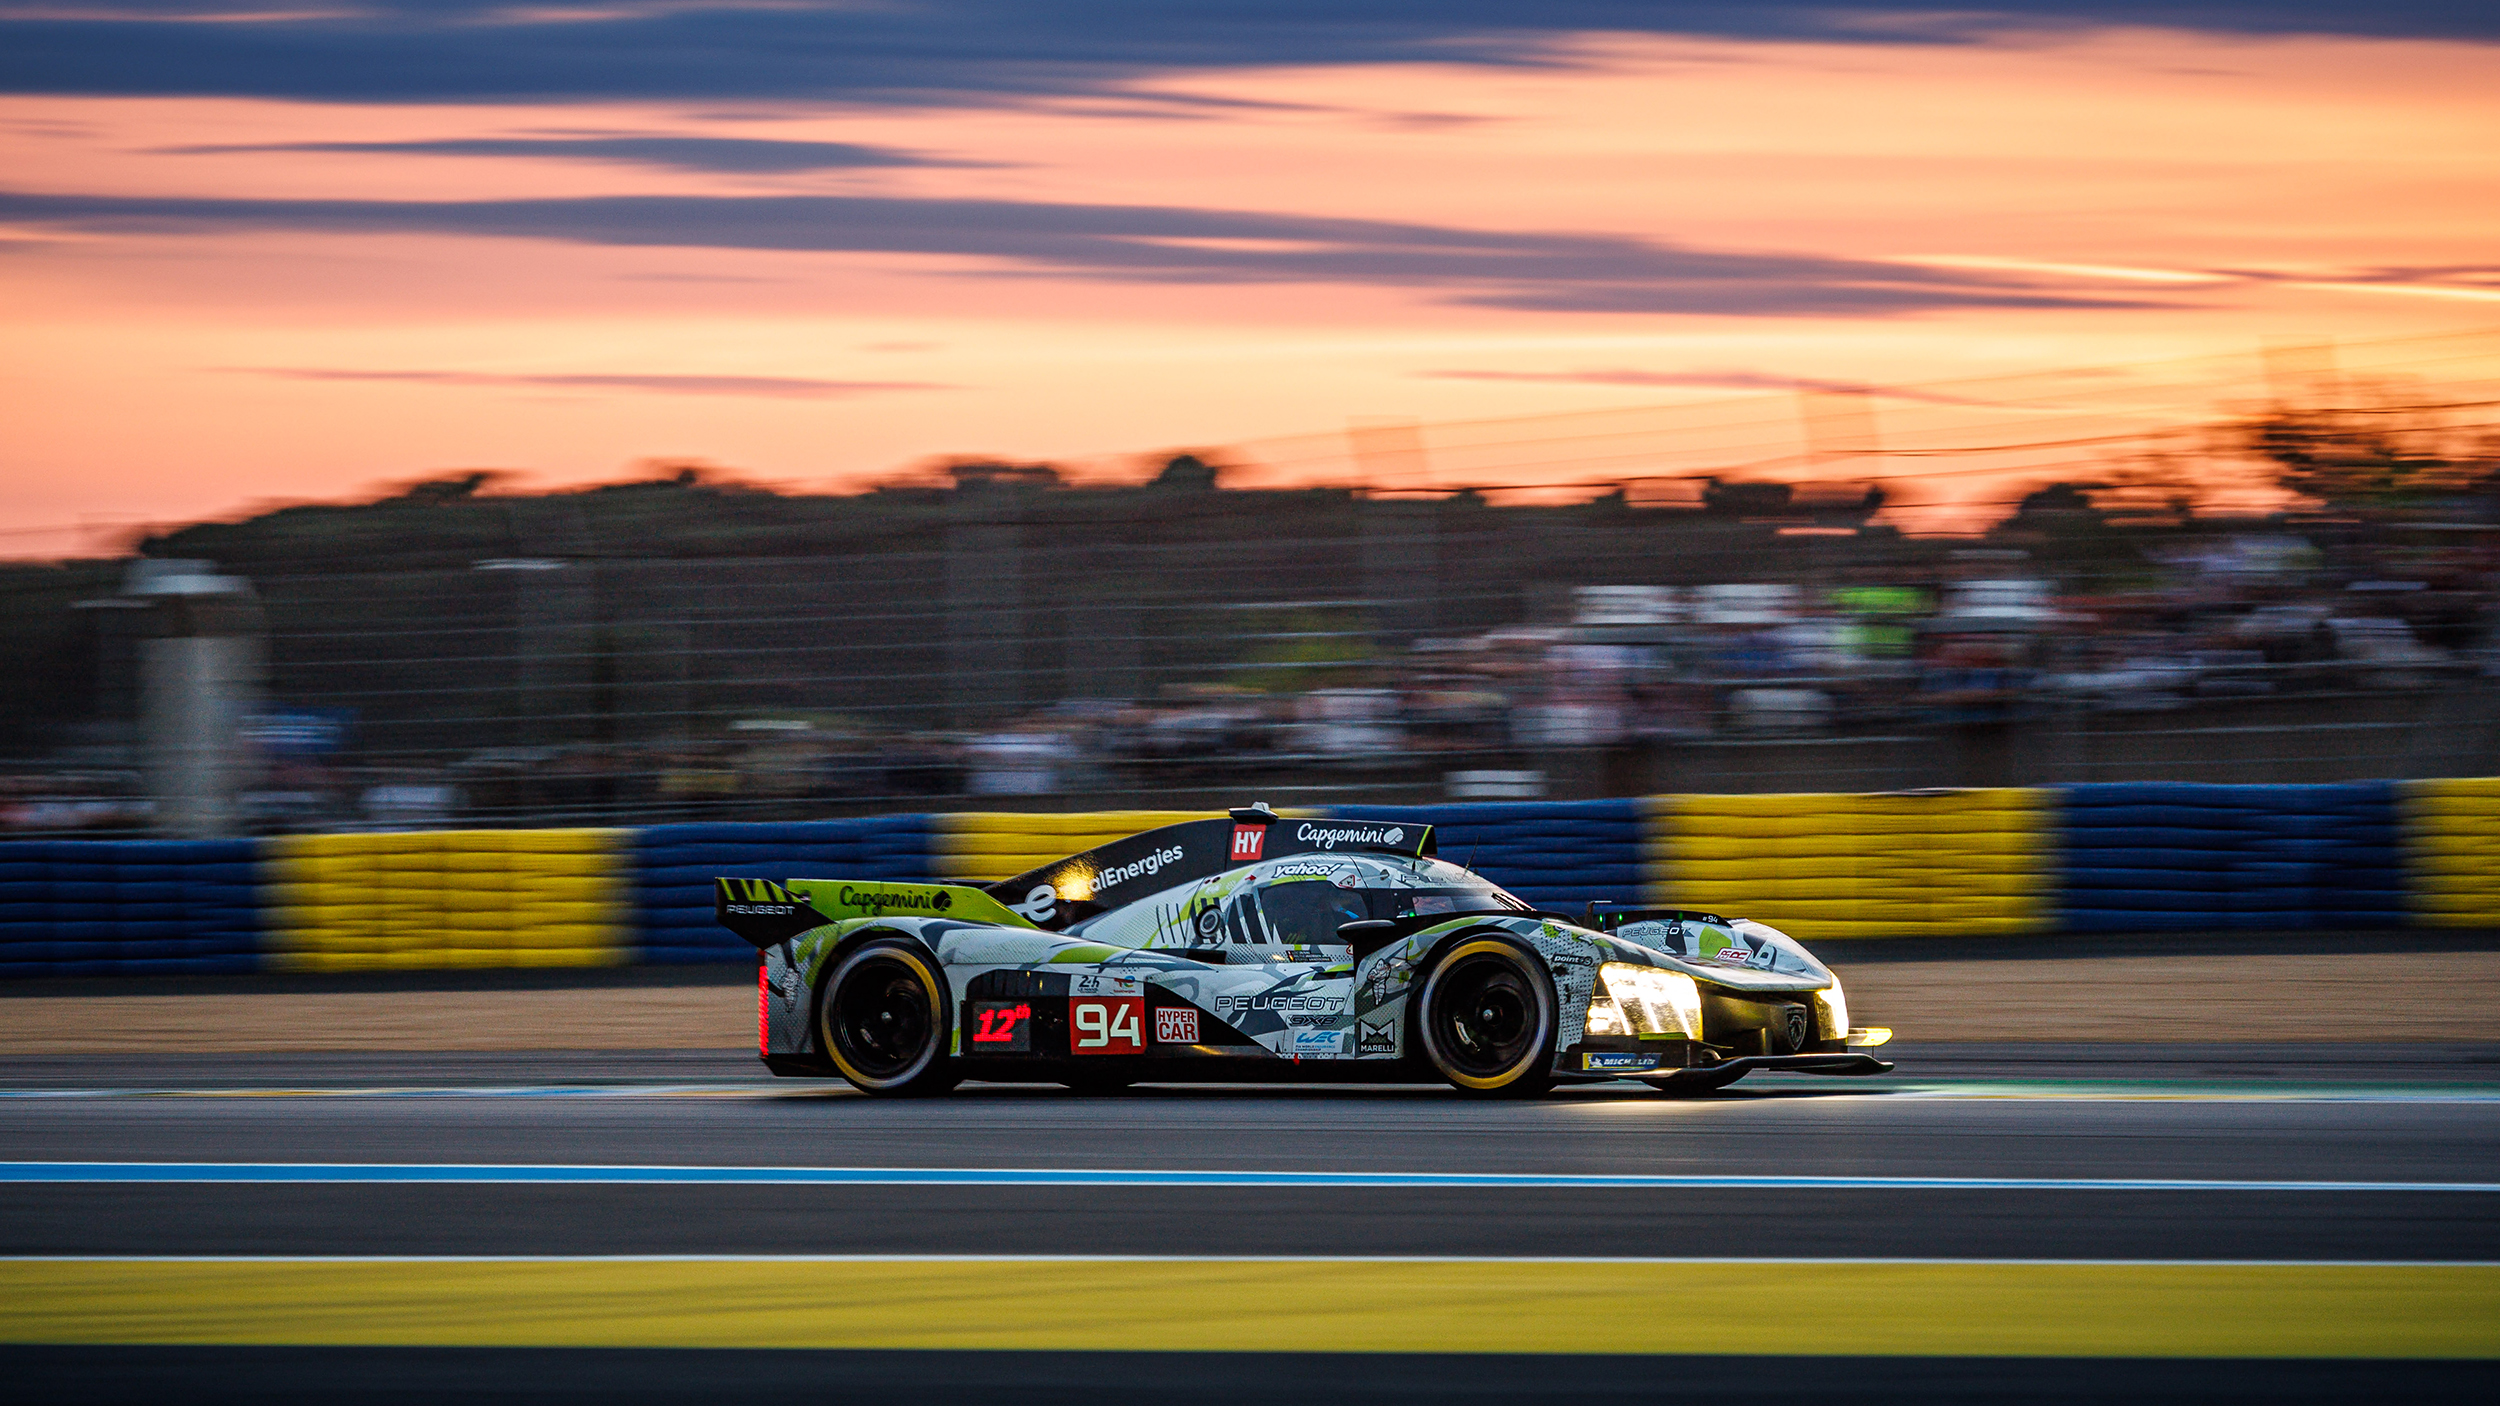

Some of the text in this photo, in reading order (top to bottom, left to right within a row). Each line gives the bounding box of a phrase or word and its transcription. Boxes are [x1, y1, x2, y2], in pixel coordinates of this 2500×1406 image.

[1234, 831, 1262, 853] HY
[1297, 823, 1384, 849] Capgemini
[1272, 863, 1344, 878] yahoo!
[839, 885, 931, 916] Capgemini
[726, 905, 795, 915] PEUGEOT
[1622, 927, 1691, 937] PEUGEOT
[1554, 955, 1580, 963] point
[1215, 996, 1346, 1011] PEUGEOT
[1158, 1010, 1195, 1023] HYPER
[1289, 1015, 1340, 1027] 9X8
[1076, 1004, 1141, 1047] 94
[1158, 1023, 1198, 1041] CAR
[1296, 1031, 1341, 1044] WEC
